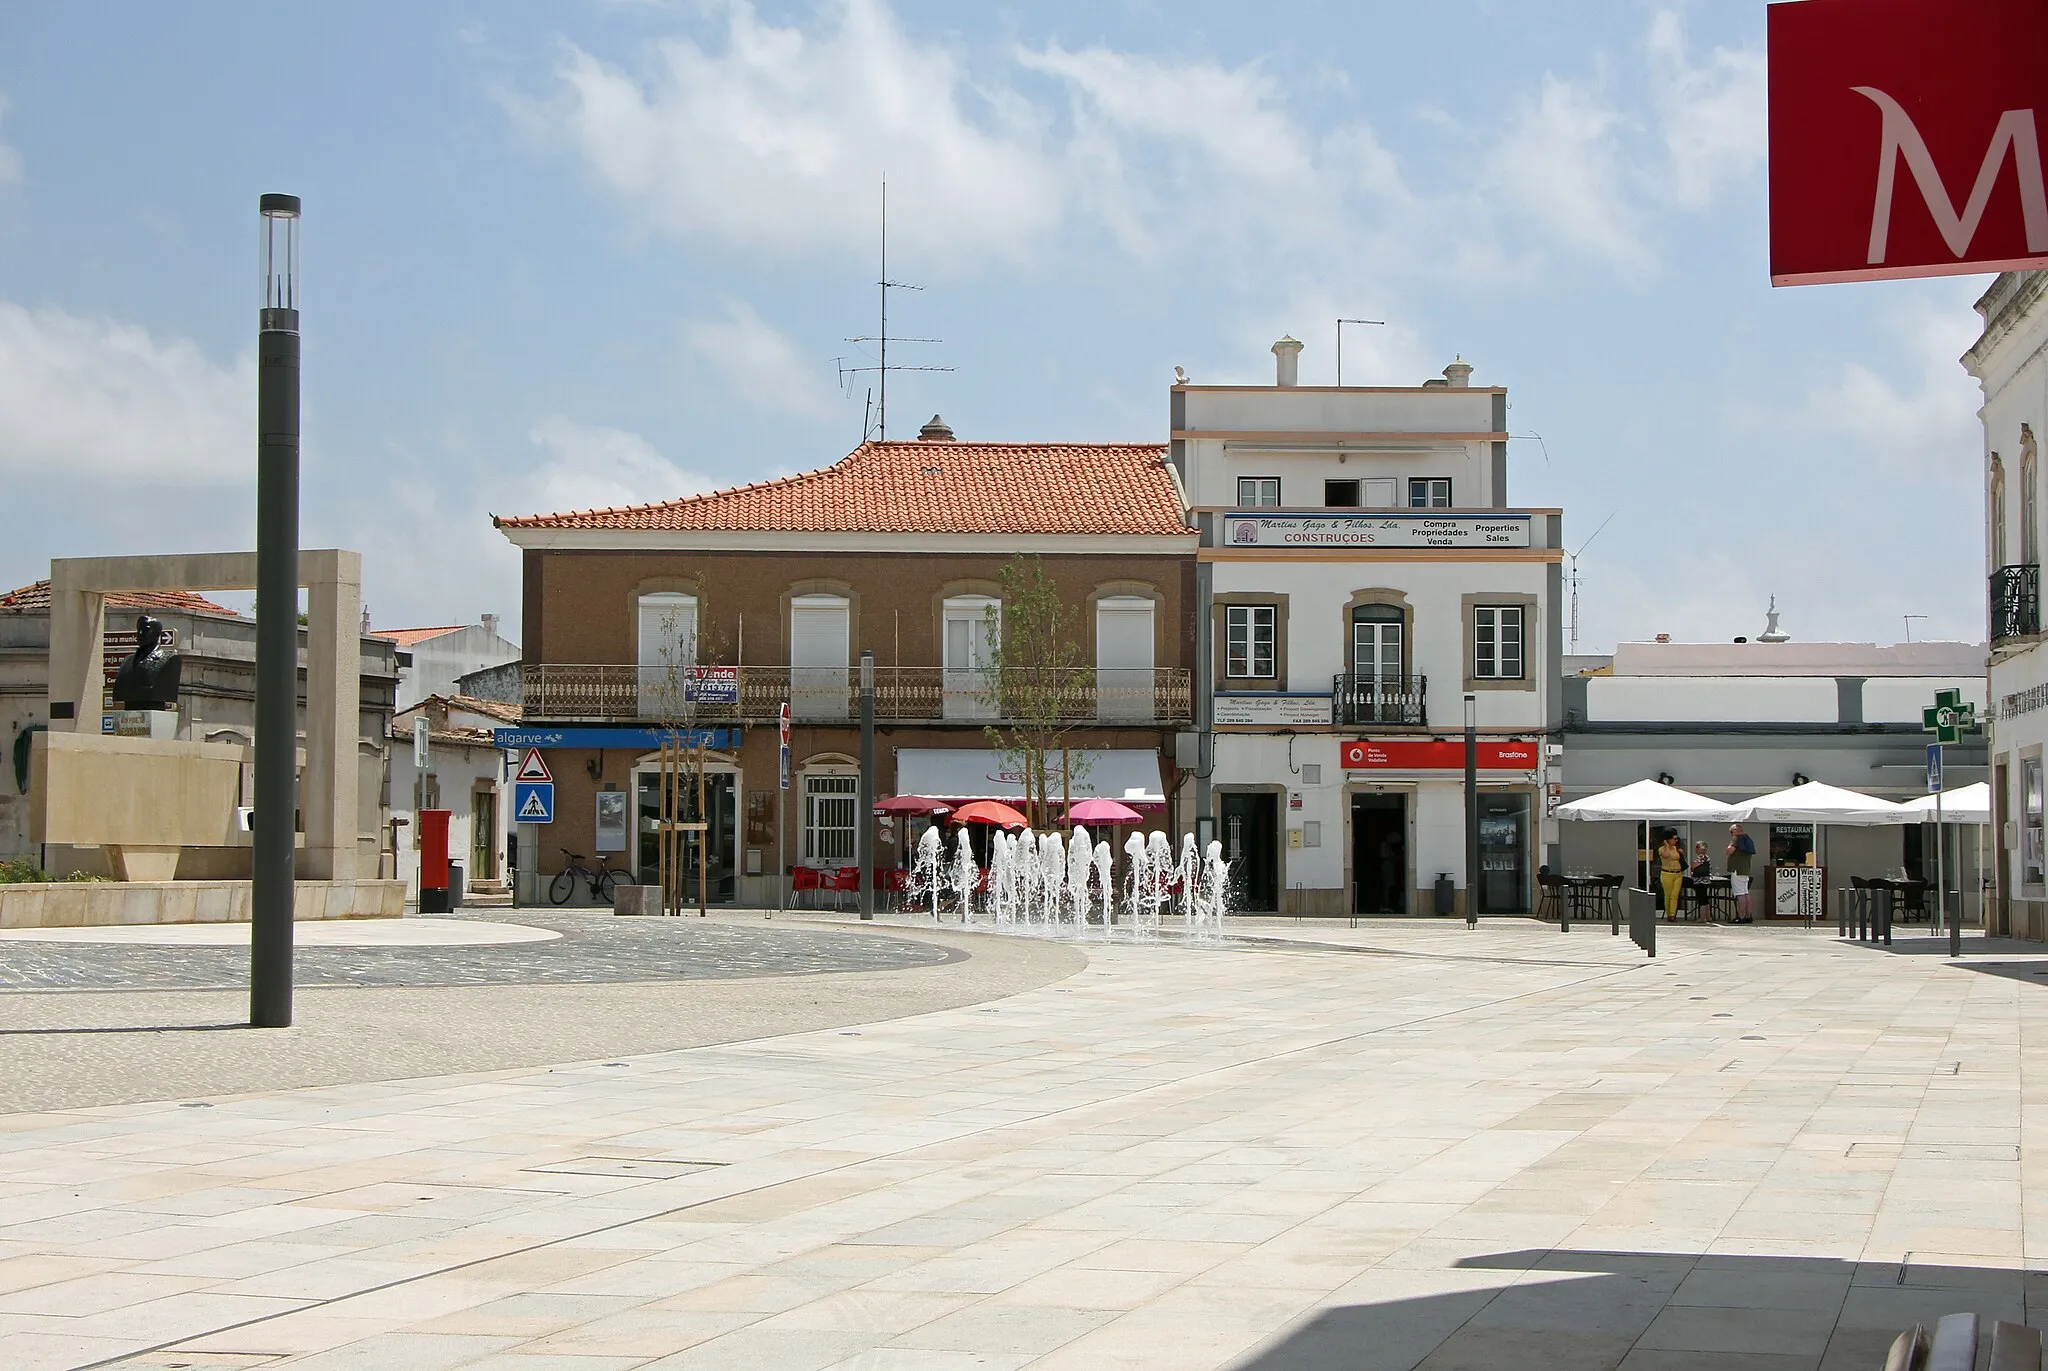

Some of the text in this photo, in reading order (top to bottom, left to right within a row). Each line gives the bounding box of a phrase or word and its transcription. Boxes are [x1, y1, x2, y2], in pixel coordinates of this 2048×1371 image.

[1848, 86, 2048, 264] M
[1260, 519, 1297, 528] Martins
[1303, 519, 1326, 531] Gago
[1331, 520, 1338, 528] &
[1423, 520, 1456, 529] Compra
[1475, 524, 1520, 533] Properties
[1284, 531, 1375, 544] CONSTRUÇÕES
[1412, 529, 1468, 537] Propriedades
[497, 732, 542, 744] algarve
[1499, 751, 1528, 759] Brasfone
[1777, 868, 1797, 878] 100
[1801, 868, 1821, 876] Wins
